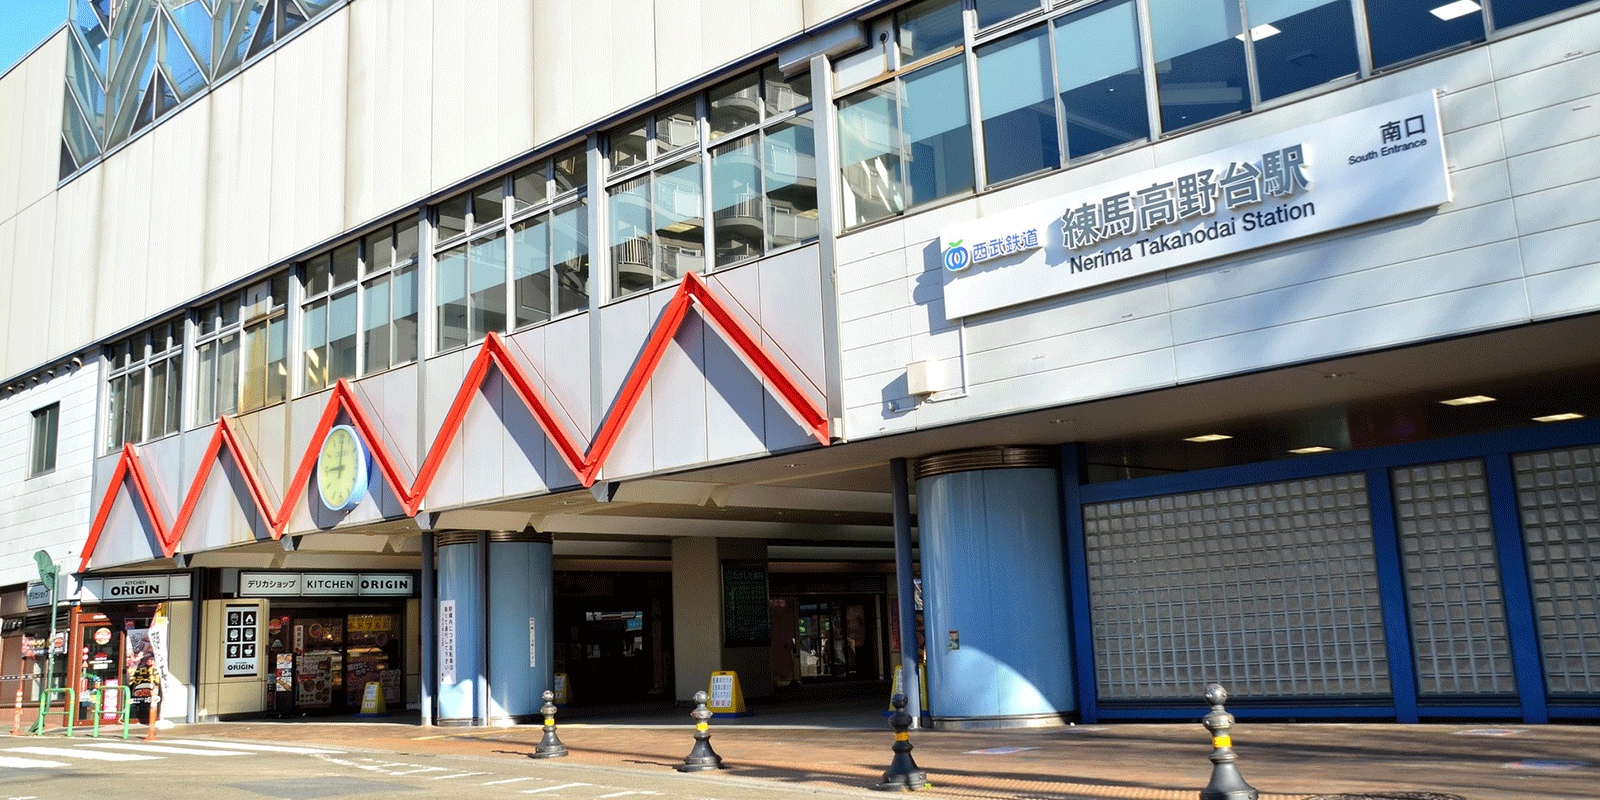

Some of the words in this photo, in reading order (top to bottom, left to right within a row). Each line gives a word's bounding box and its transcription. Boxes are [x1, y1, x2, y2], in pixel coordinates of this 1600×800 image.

[1379, 117, 1427, 145] 南口
[1348, 151, 1378, 166] South
[1380, 139, 1427, 158] Entrance
[1061, 144, 1310, 250] 練馬高野台駅
[972, 228, 1040, 263] 西武鉄道
[1069, 249, 1133, 275] Nerima
[1136, 219, 1236, 257] Takanodai
[1242, 200, 1316, 232] Station
[111, 585, 159, 596] ORIGIN
[248, 579, 296, 589] デリカショップ
[307, 580, 354, 589] KITCHEN
[361, 580, 408, 589] ORIGIN
